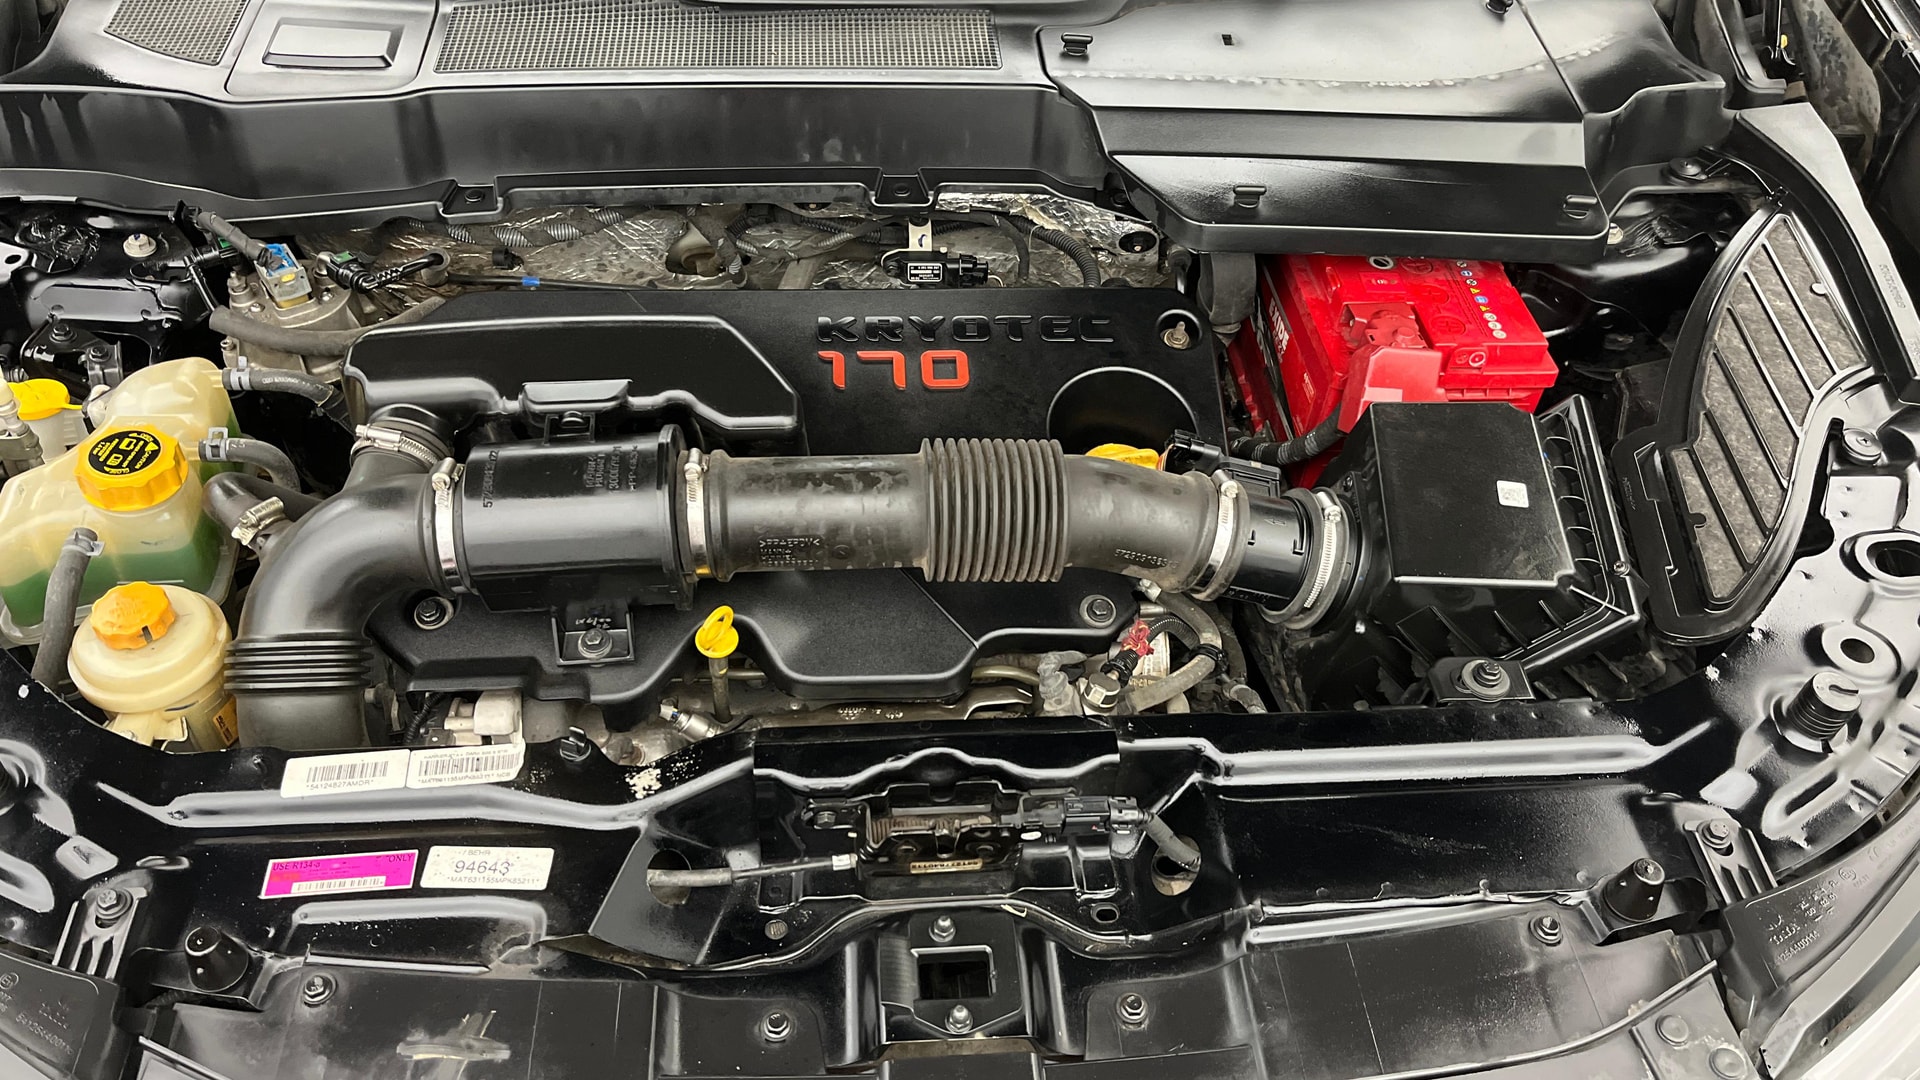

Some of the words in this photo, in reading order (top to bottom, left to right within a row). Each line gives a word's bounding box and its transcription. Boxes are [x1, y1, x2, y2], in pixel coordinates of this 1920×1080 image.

[816, 315, 1115, 342] KRYOTEC
[1268, 297, 1290, 352] EXIDE
[817, 350, 971, 390] 170
[454, 860, 511, 875] 94643
